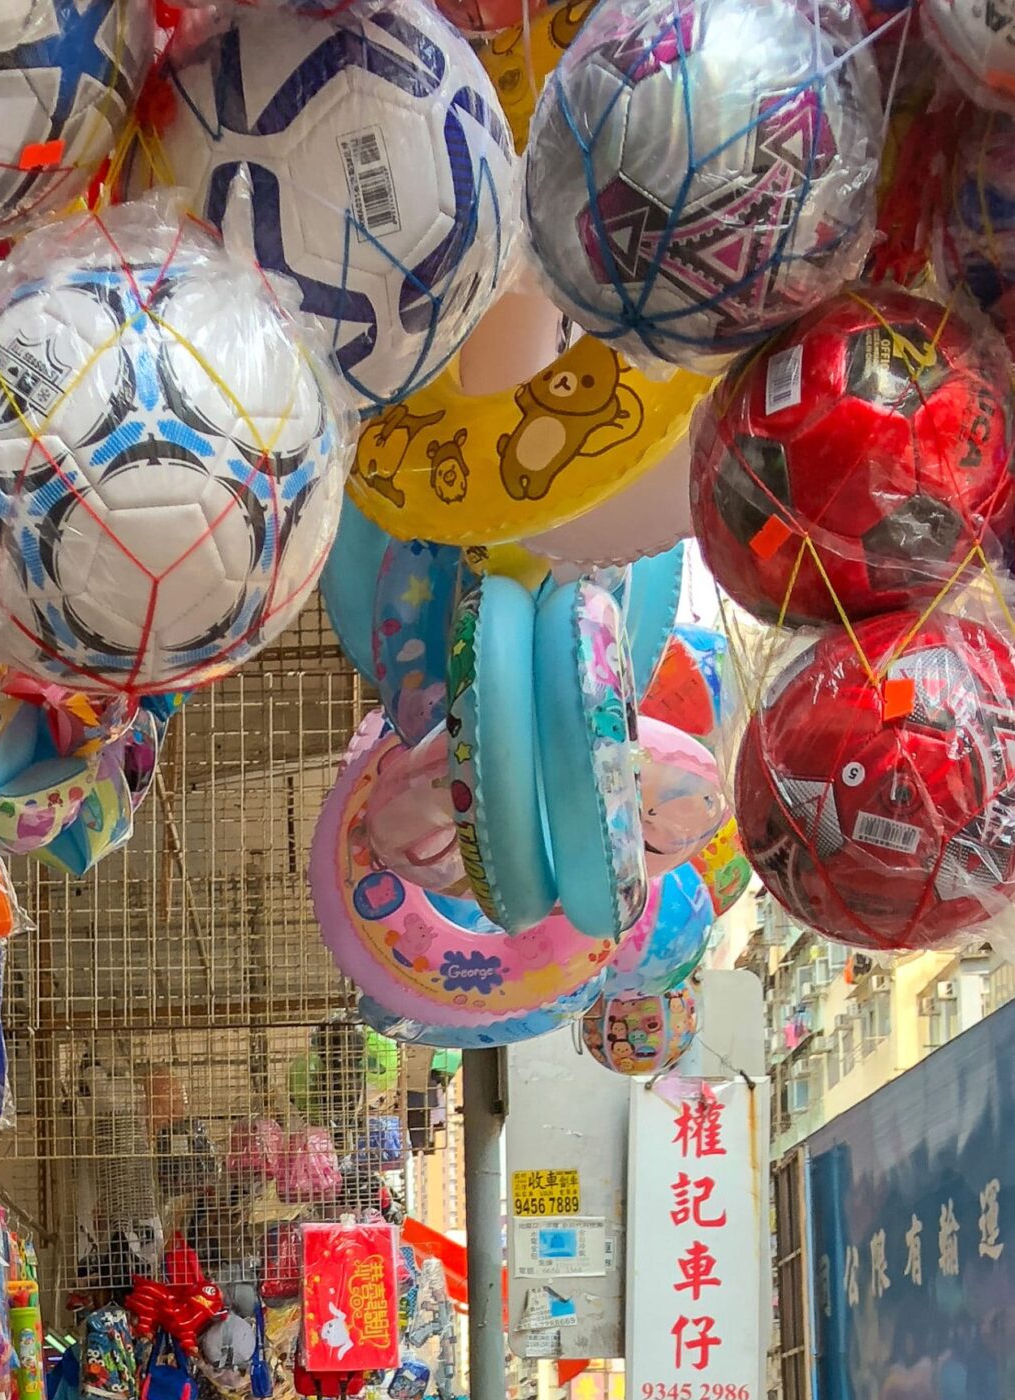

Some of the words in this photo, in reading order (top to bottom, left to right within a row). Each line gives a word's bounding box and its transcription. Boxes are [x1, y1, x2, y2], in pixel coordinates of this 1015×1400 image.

[447, 964, 495, 980] George
[515, 1198, 546, 1215] 9456
[548, 1196, 579, 1213] 7889
[670, 1098, 727, 1371] 權記車仔
